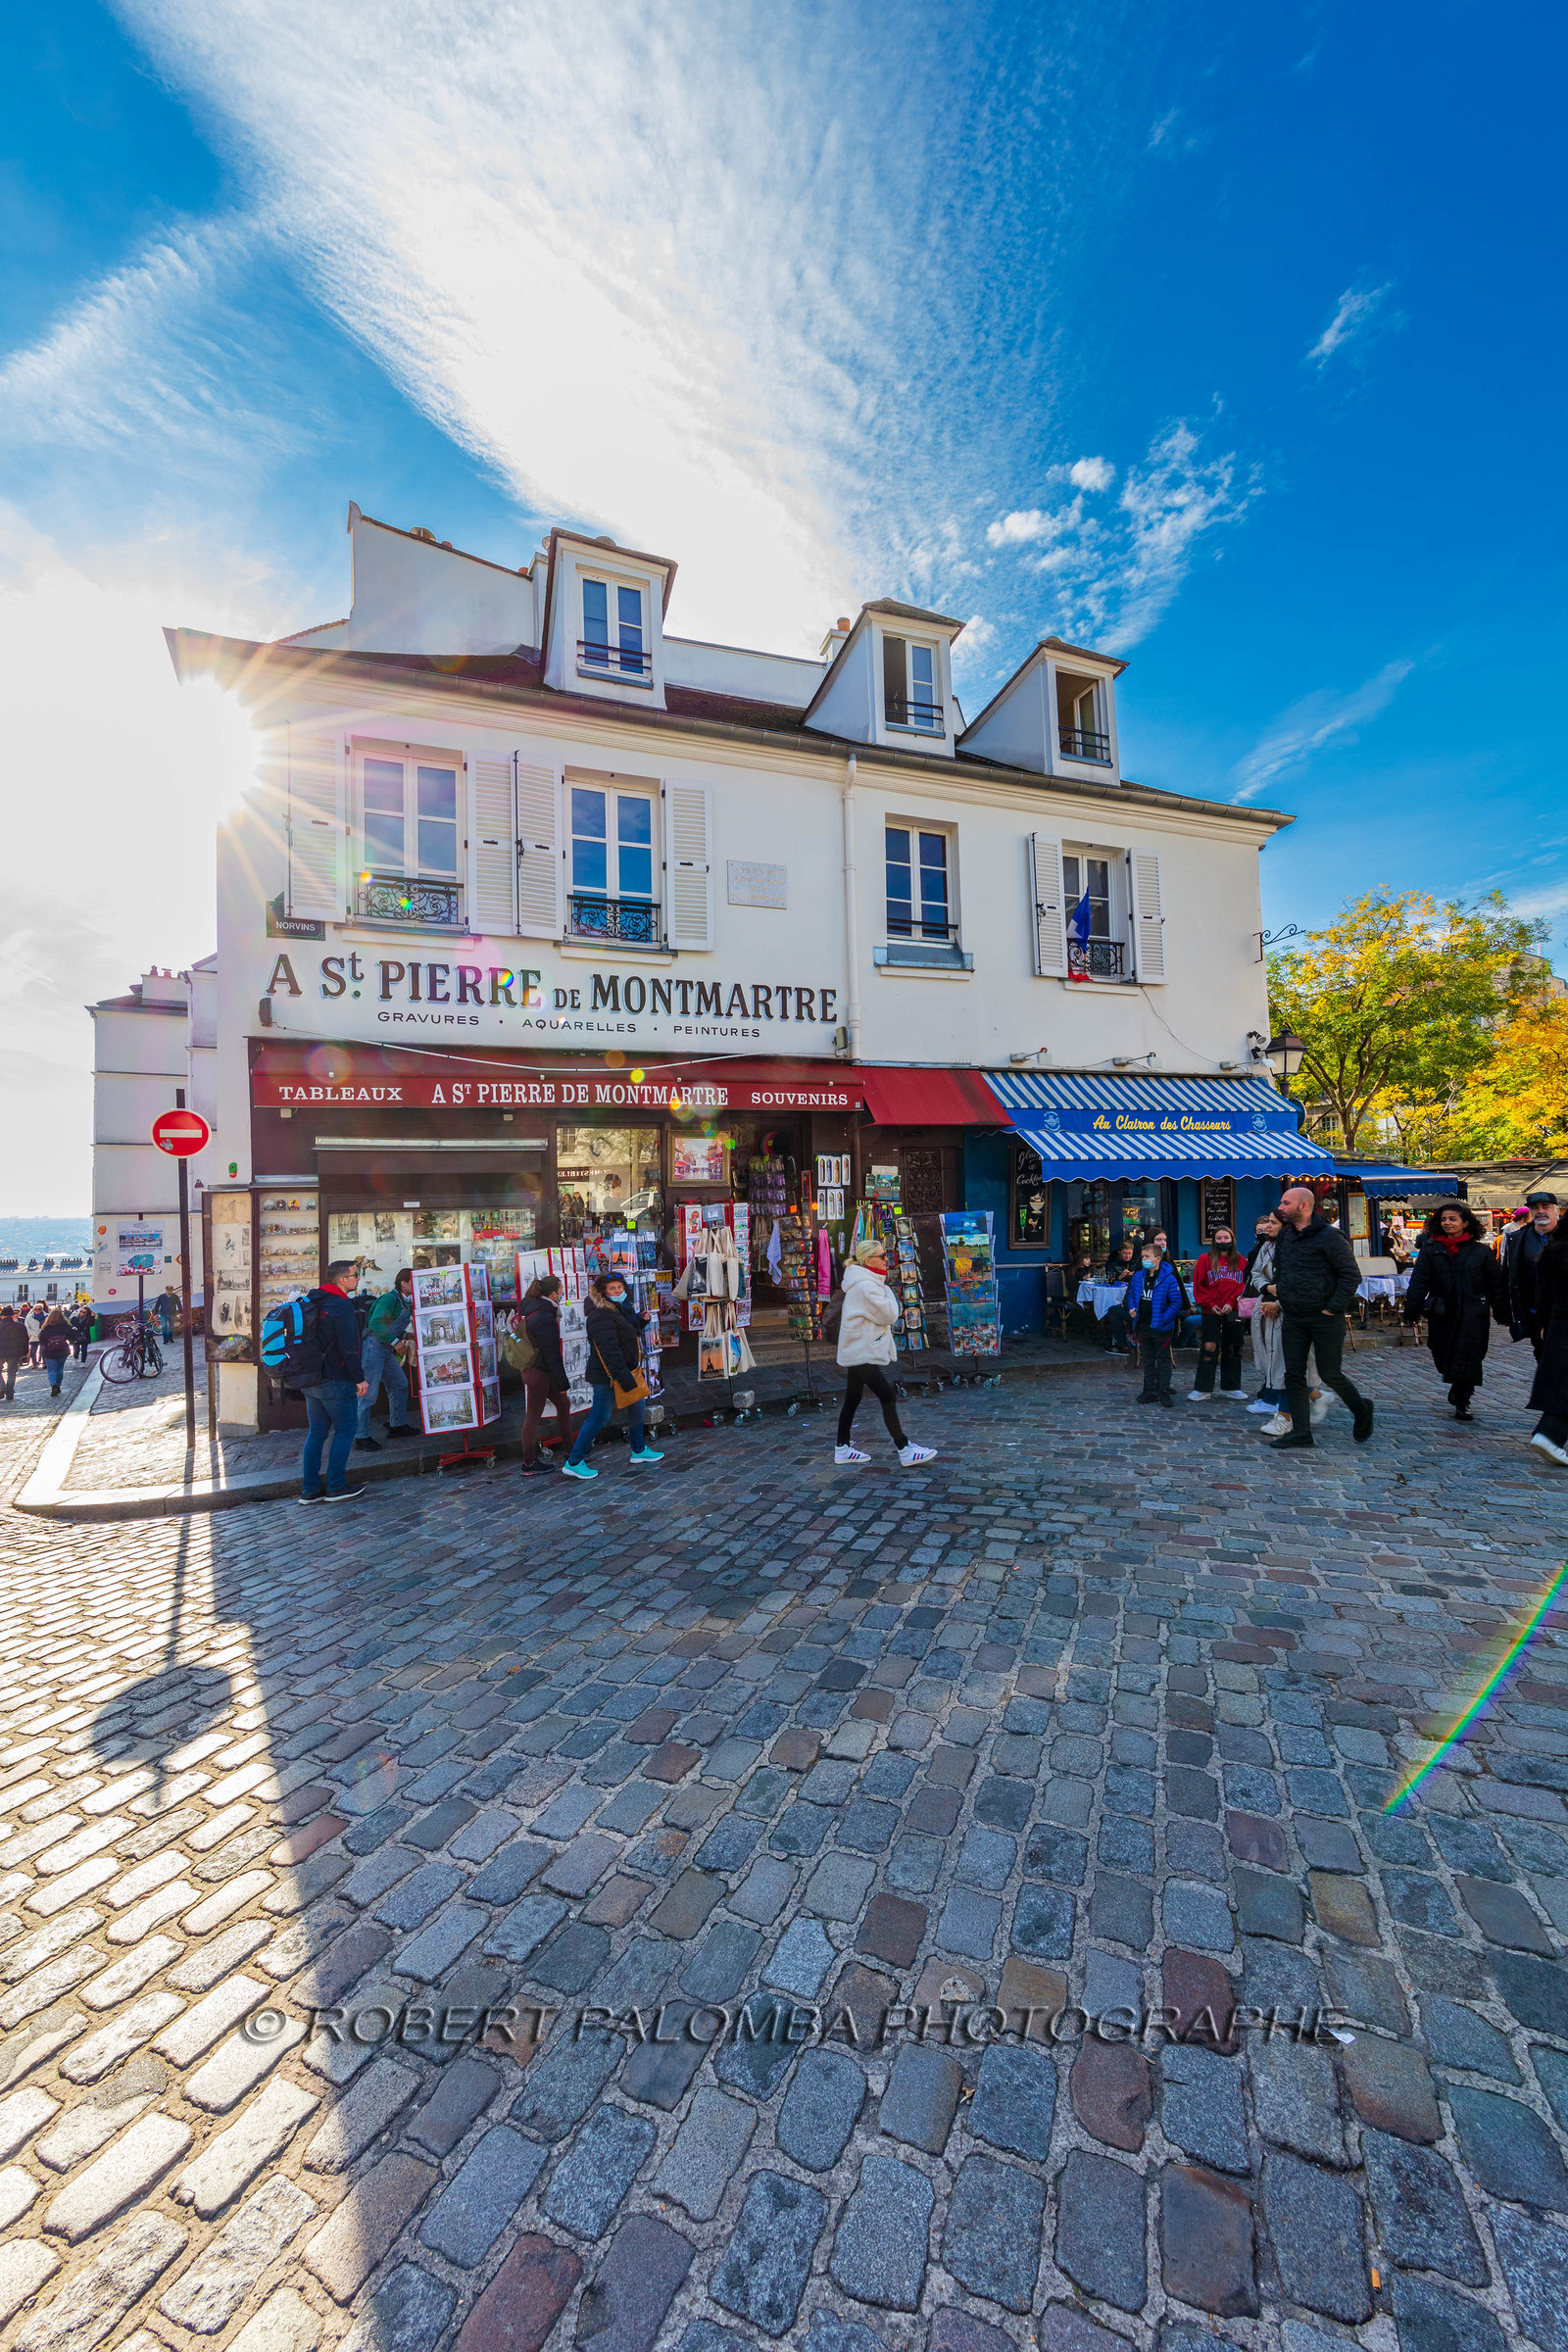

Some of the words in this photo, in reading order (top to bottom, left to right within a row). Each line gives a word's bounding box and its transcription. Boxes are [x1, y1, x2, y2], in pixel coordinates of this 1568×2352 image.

[275, 920, 316, 932] NORVINS
[265, 953, 303, 998] A
[376, 959, 543, 1009] PIERRE
[553, 988, 581, 1010] DE
[590, 973, 838, 1024] MONTMARTRE
[377, 1011, 479, 1026] GRAVURES
[521, 1018, 637, 1034] AQUARELLES
[673, 1025, 760, 1039] PEINTURES
[278, 1086, 404, 1102] TABLEAUX
[431, 1083, 447, 1104] A
[476, 1083, 556, 1104] PIERRE
[561, 1083, 589, 1104] DE
[594, 1084, 729, 1106] MONTMARTRE
[750, 1091, 850, 1106] SOUVENIRS
[1092, 1113, 1112, 1131] Au
[1115, 1113, 1156, 1131] Clairon
[1159, 1114, 1179, 1131] des
[1180, 1114, 1232, 1132] Chasseurs
